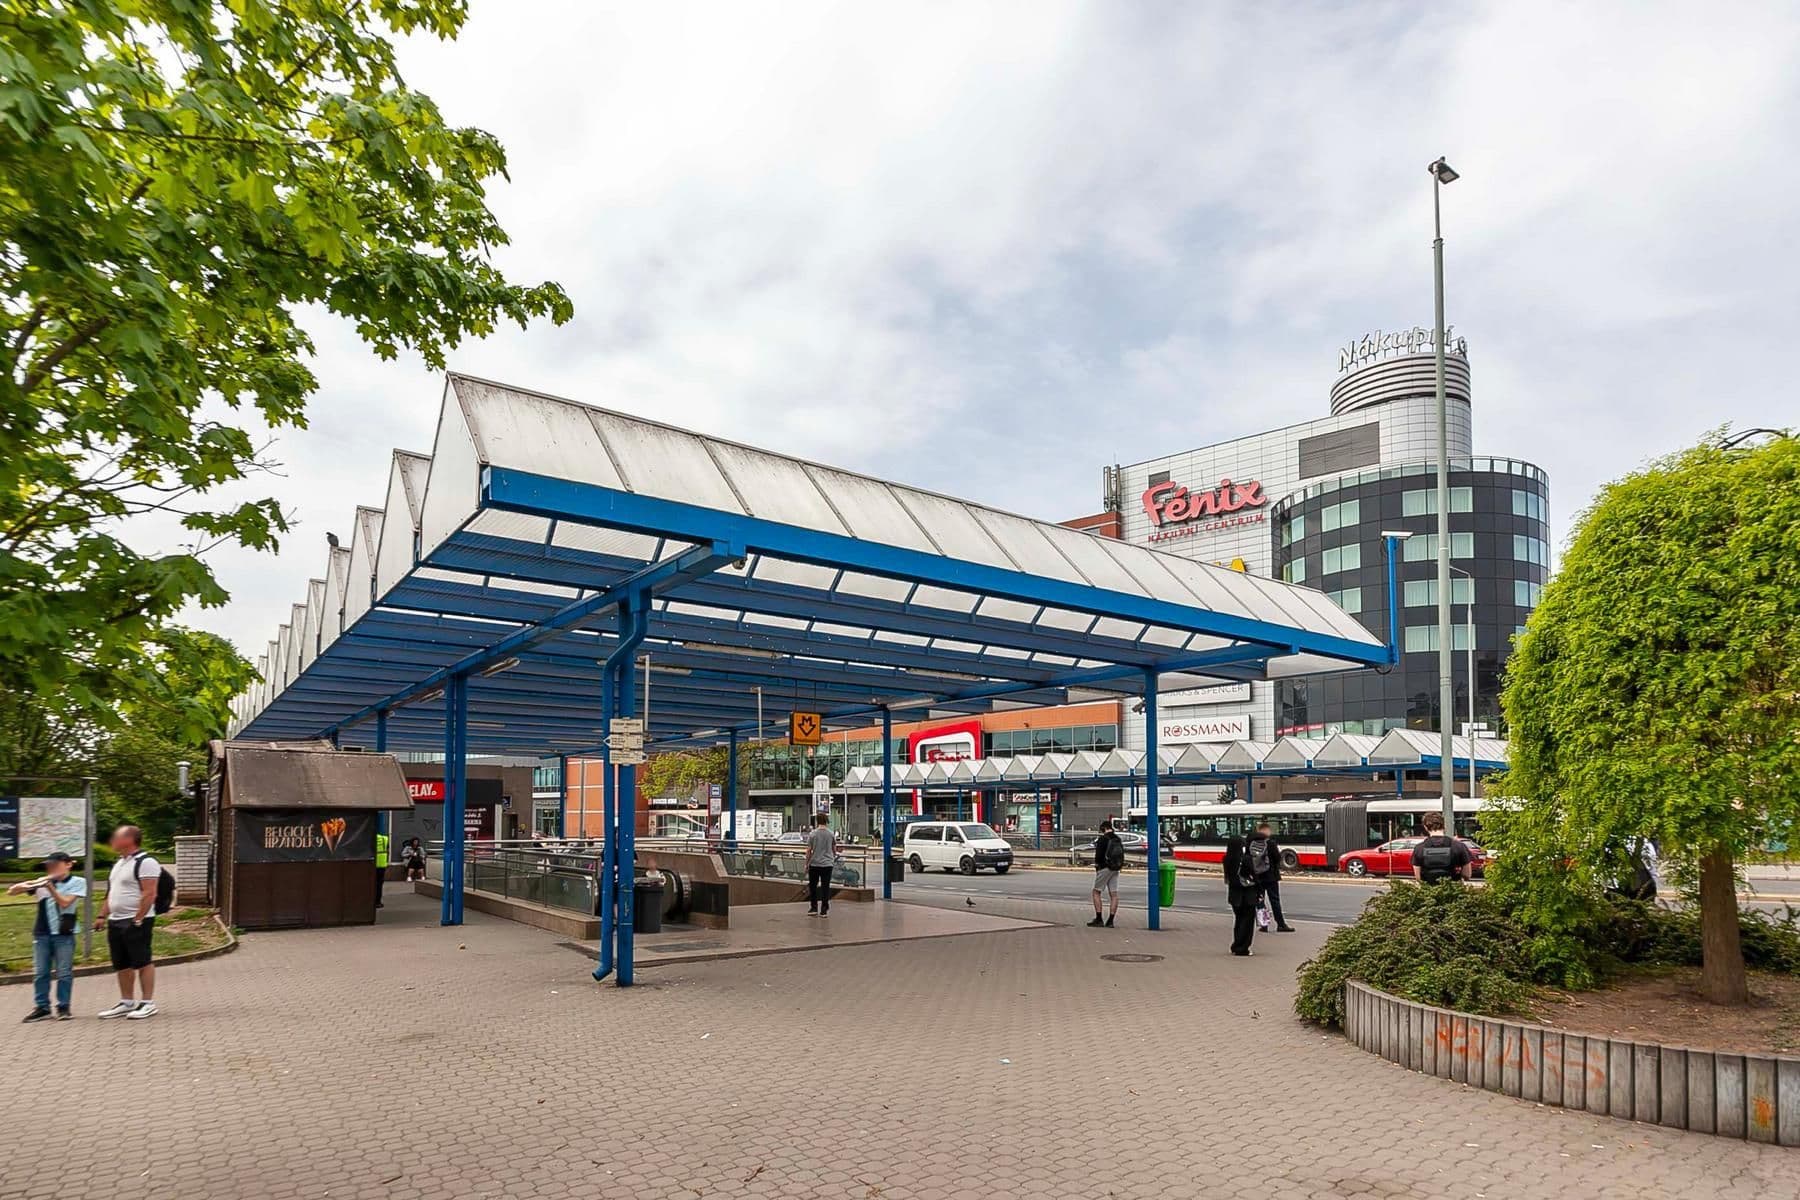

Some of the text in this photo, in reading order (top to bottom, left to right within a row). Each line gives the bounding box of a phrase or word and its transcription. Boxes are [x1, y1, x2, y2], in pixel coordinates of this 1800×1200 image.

[1142, 479, 1267, 527] Fénix
[1148, 514, 1264, 543] NÁKUPNÍ CENTRUM
[1163, 722, 1242, 737] ROSSMANN
[408, 783, 434, 797] ELAY
[265, 823, 315, 837] BELGICKÉ
